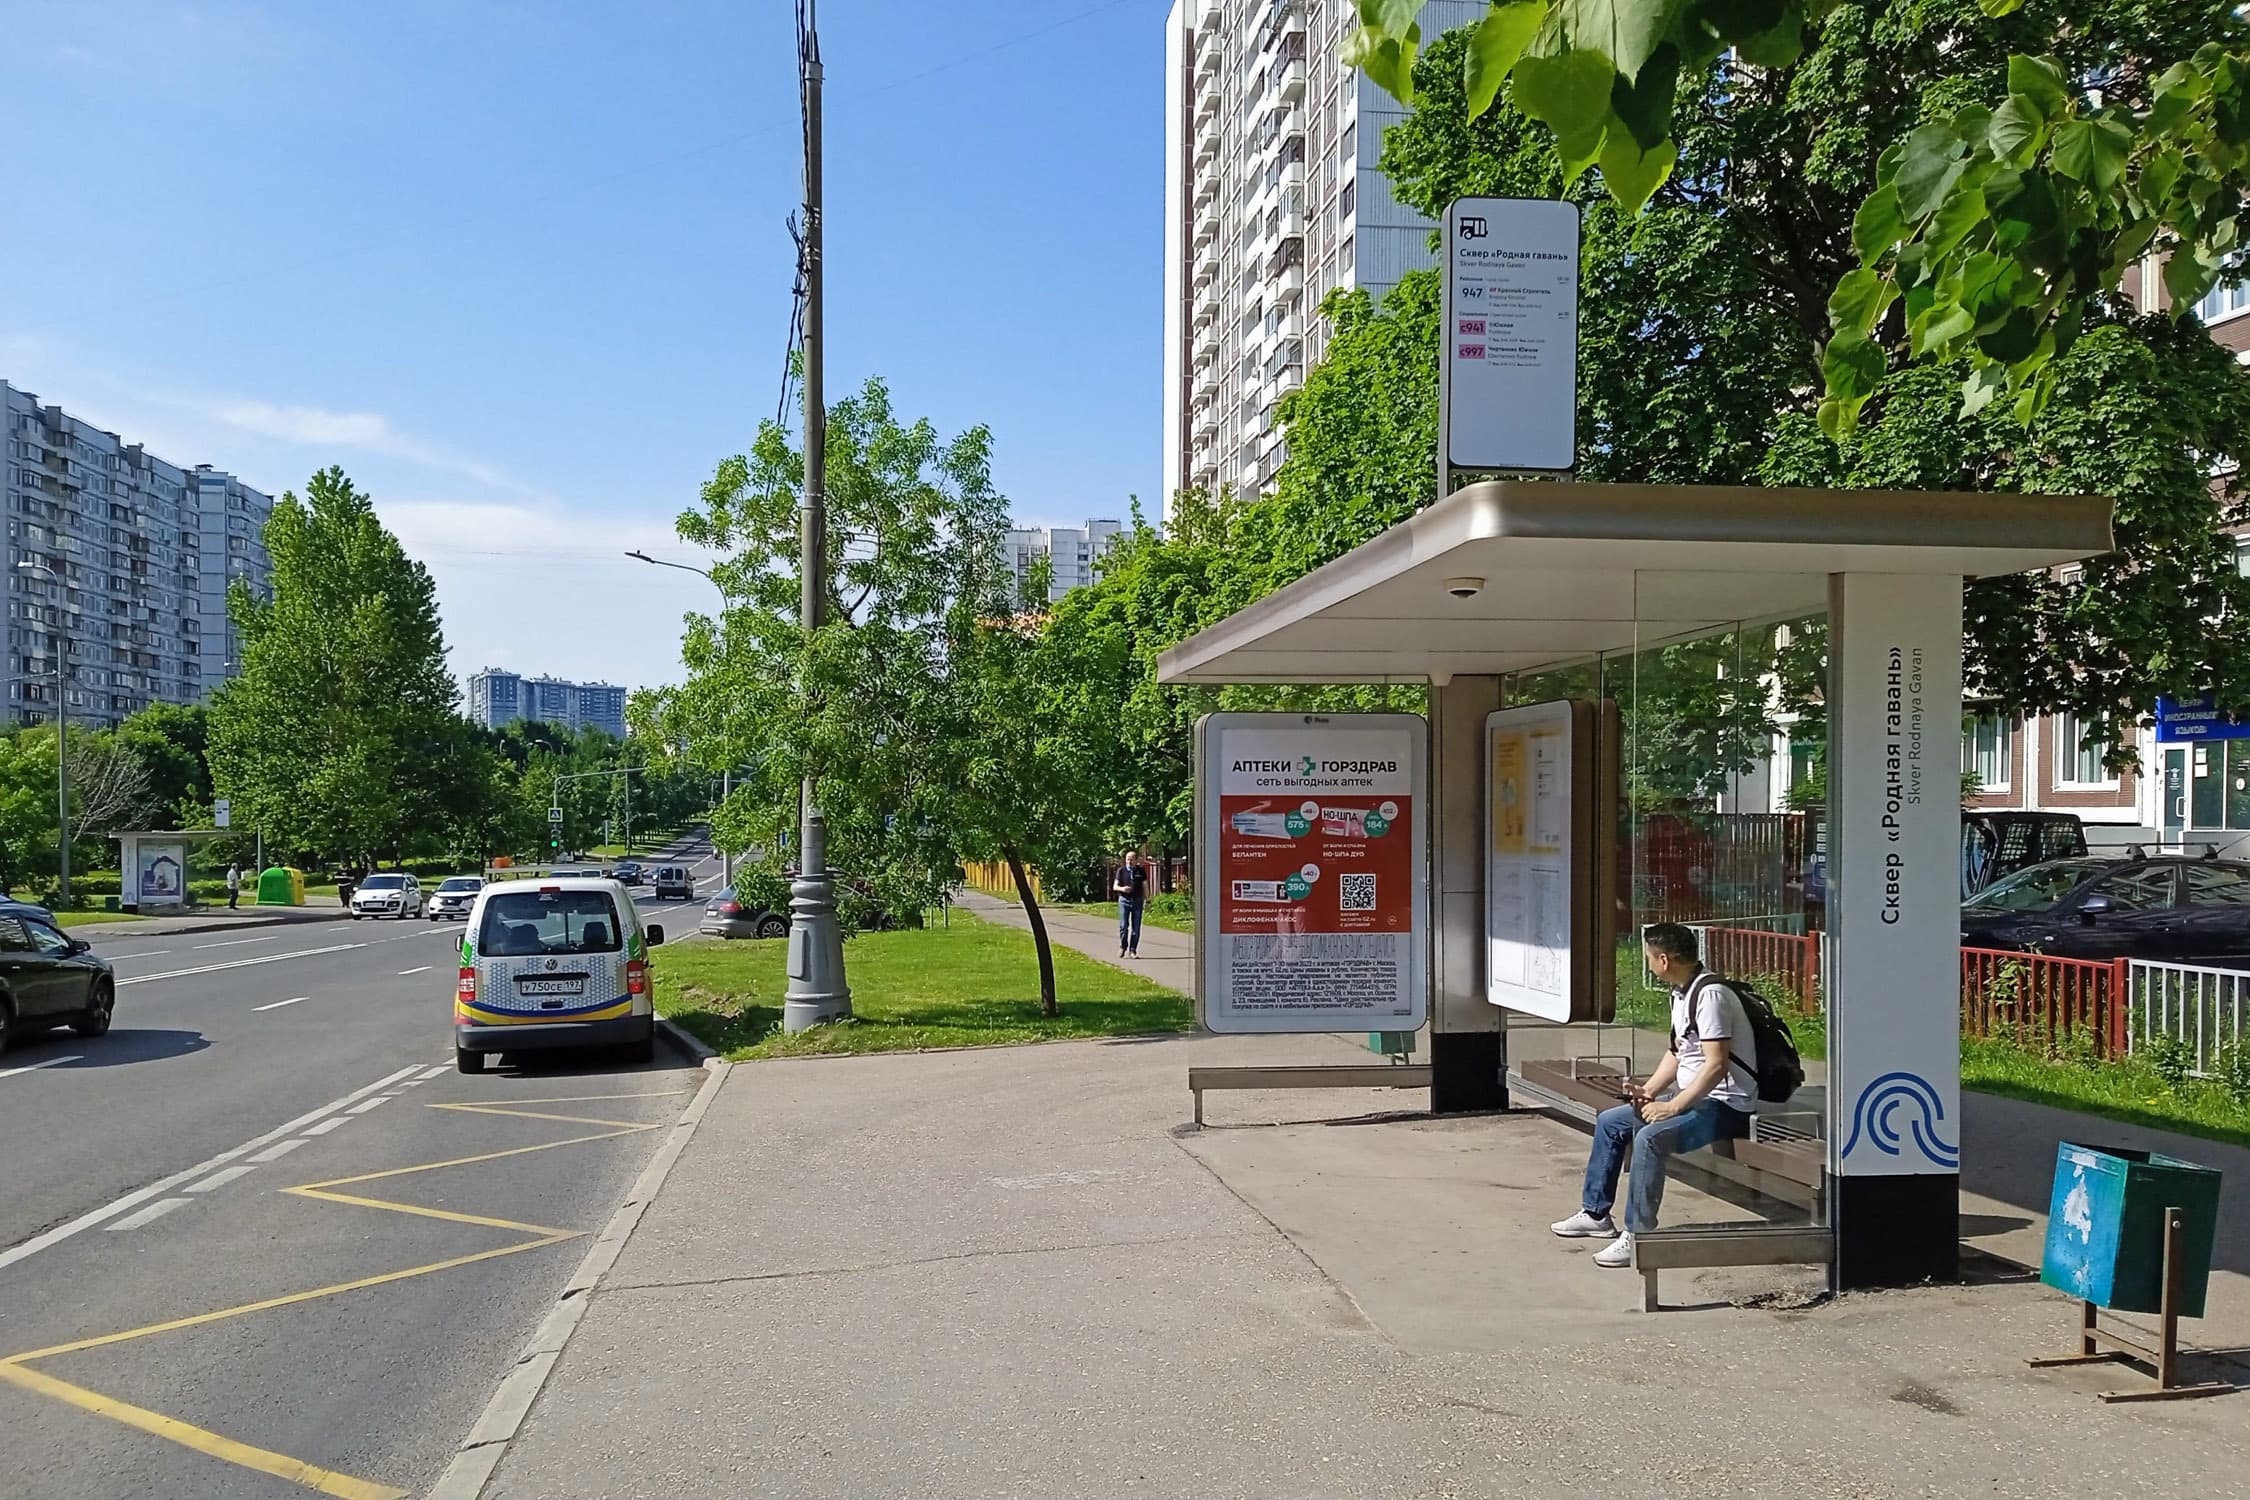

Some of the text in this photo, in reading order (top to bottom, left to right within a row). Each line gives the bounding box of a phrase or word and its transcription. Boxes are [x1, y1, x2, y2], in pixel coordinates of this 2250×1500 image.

[1460, 248, 1568, 260] Сквер «Родная гавань»
[1462, 287, 1483, 298] 947
[1460, 322, 1484, 333] с941
[1460, 347, 1484, 357] с997
[1908, 648, 1922, 805] Skver Rodnaya Gavan
[1232, 760, 1397, 774] АПТЕКИ ГОРЗДРАВ
[1256, 778, 1373, 788] сеть выгодных аптек
[1881, 647, 1904, 925] Сквер «Родная гавань»
[1323, 809, 1358, 820] НО-ШПА
